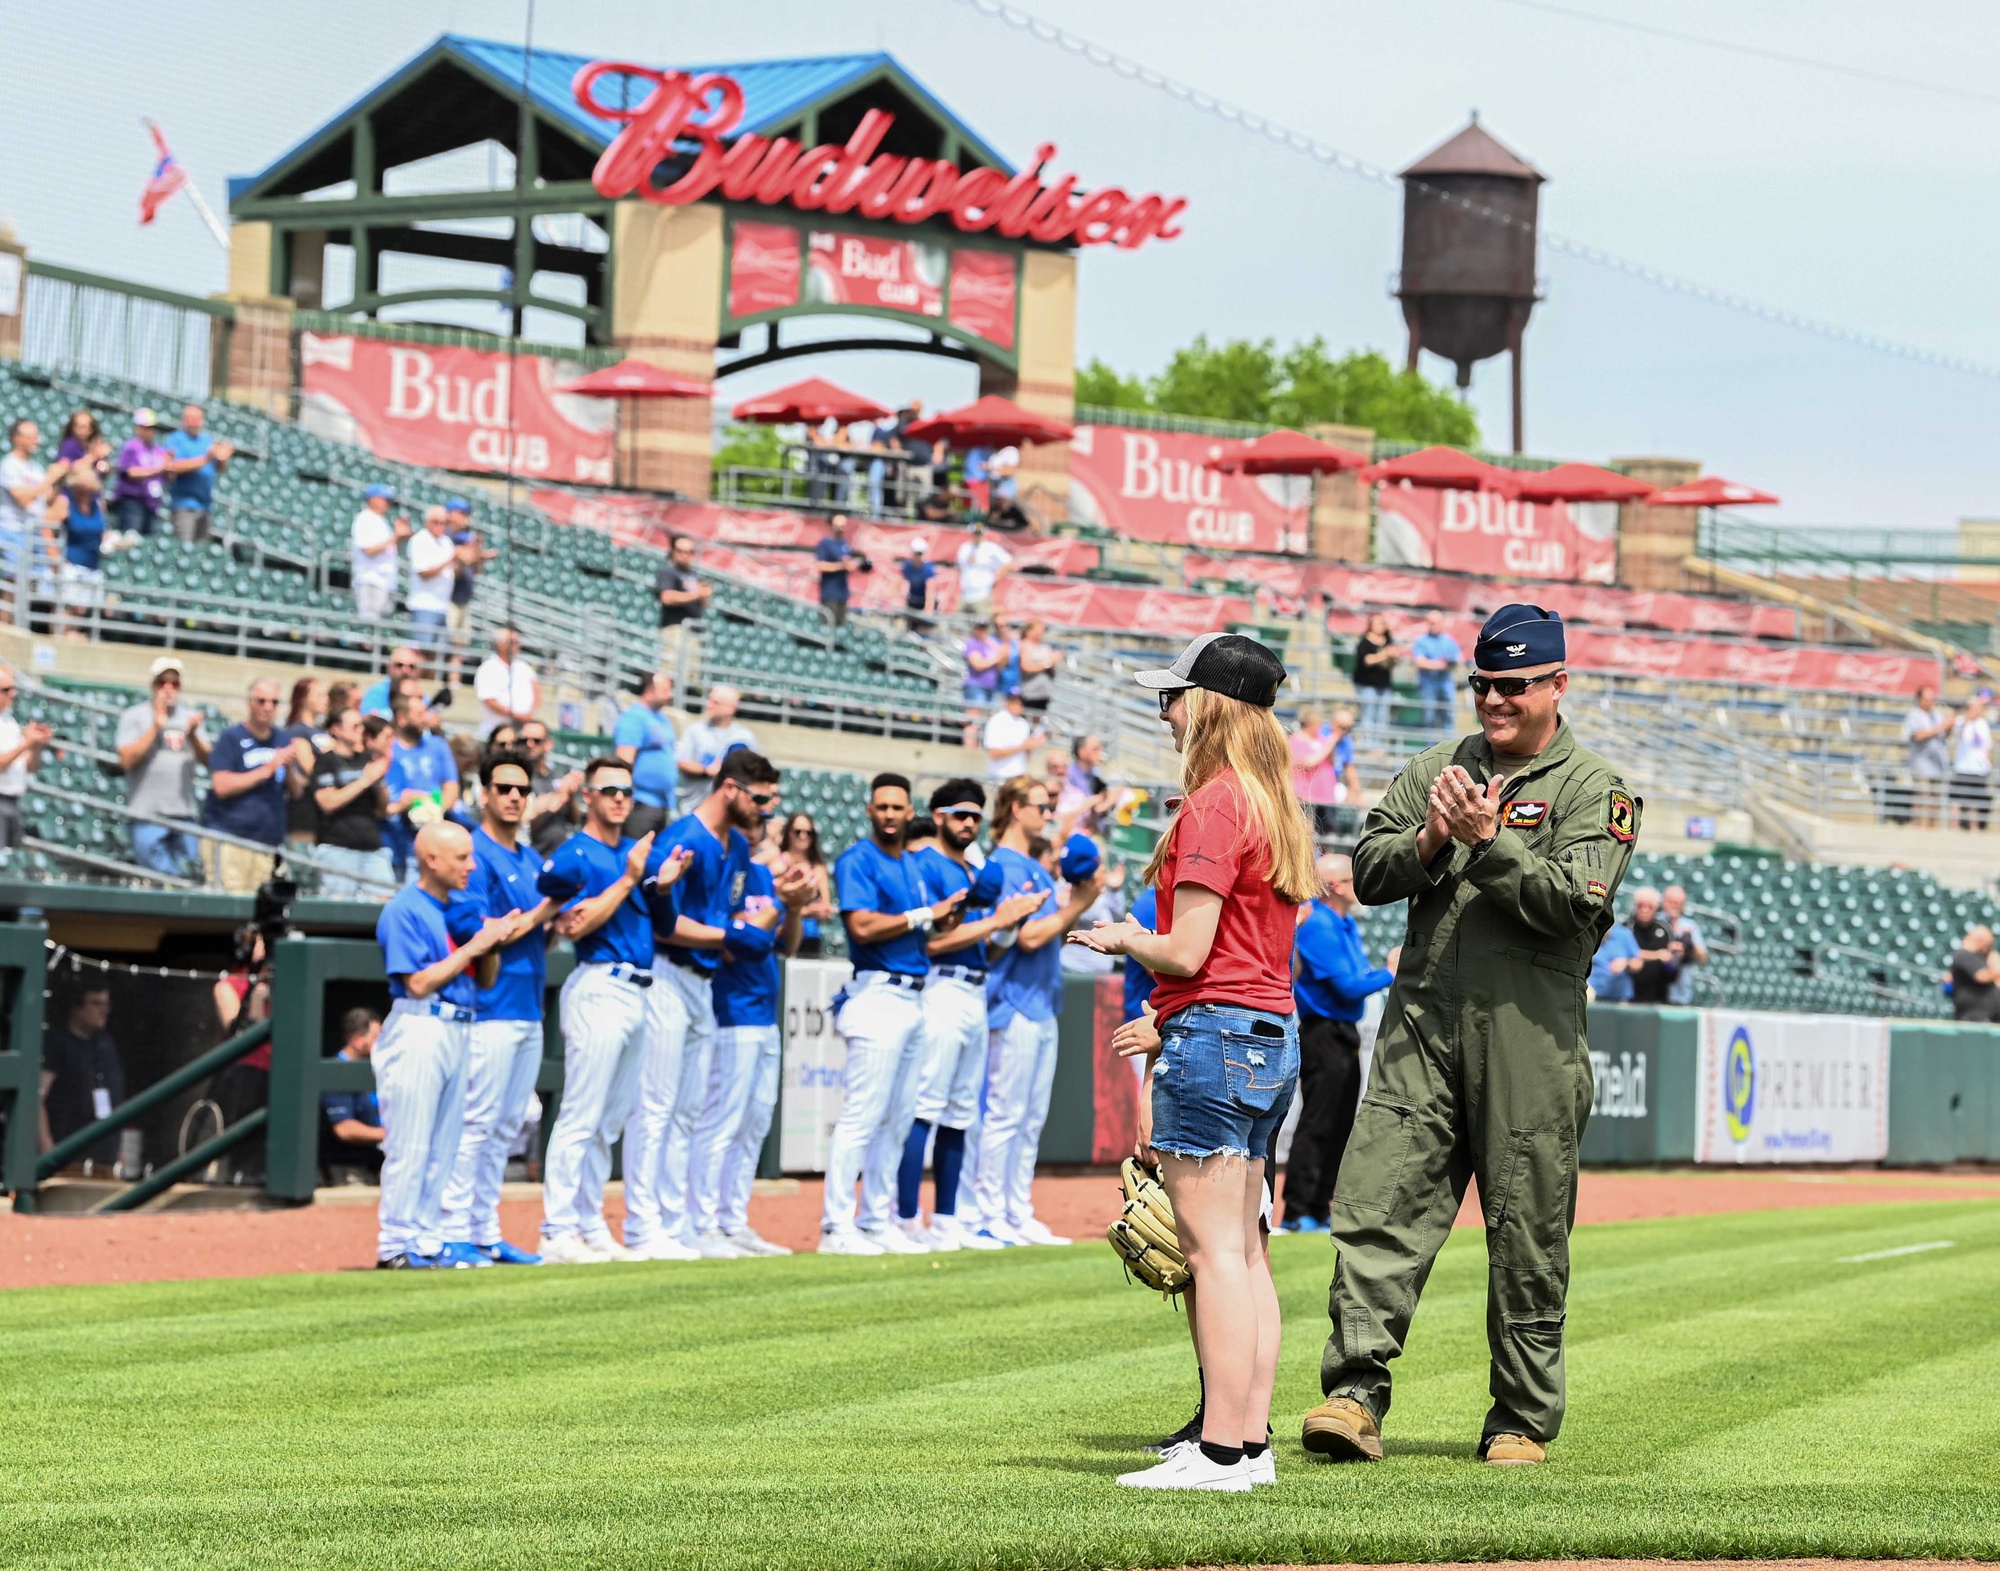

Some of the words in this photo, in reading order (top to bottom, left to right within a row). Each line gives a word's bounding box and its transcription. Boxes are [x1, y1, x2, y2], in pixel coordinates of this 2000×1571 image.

[572, 60, 1188, 250] Budweiser
[841, 238, 901, 281] Bud
[386, 346, 512, 428] Bud
[466, 428, 550, 472] CLUB
[1120, 432, 1223, 507] Bud
[1186, 506, 1255, 545] CLUB
[1757, 1060, 1873, 1111] PREMIER
